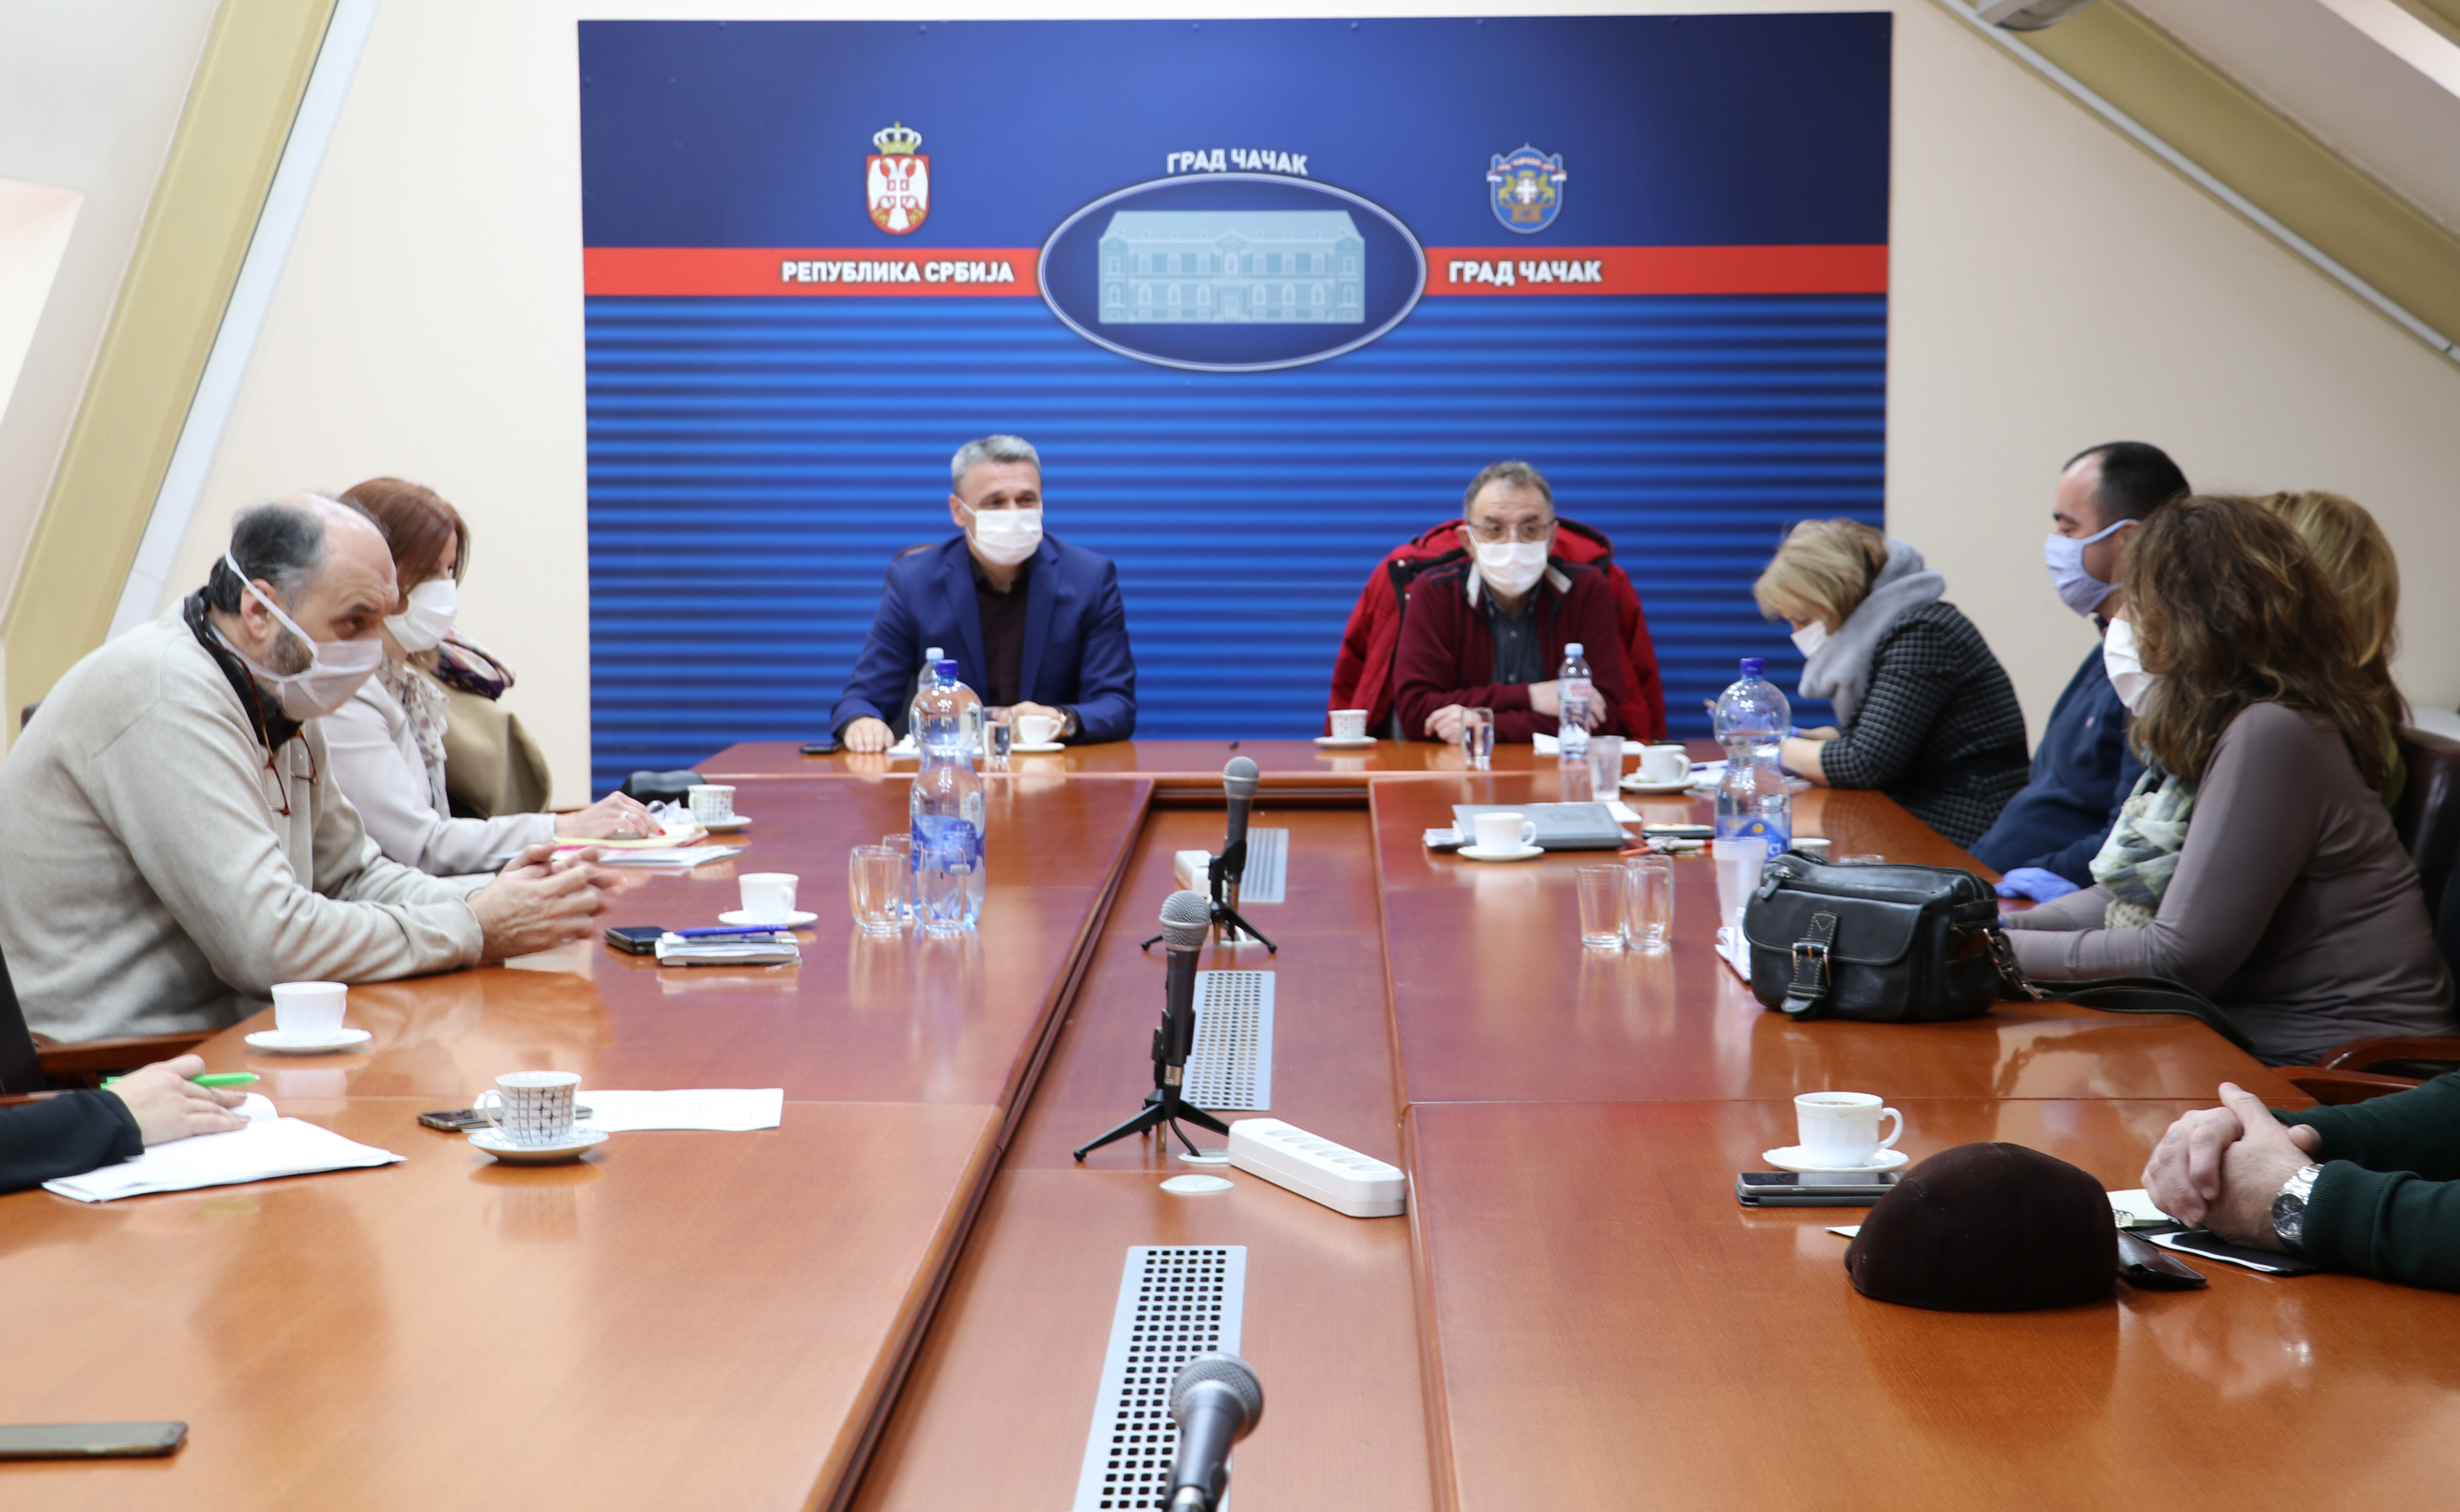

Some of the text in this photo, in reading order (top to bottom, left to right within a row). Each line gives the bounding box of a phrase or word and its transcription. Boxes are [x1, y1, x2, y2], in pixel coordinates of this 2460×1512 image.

[1167, 149, 1308, 175] ГРАД ЧАЧАК
[782, 261, 1014, 283] РЕПУБЛИКА СРБИЈА
[1449, 260, 1602, 286] ГРАД ЧАЧАК
